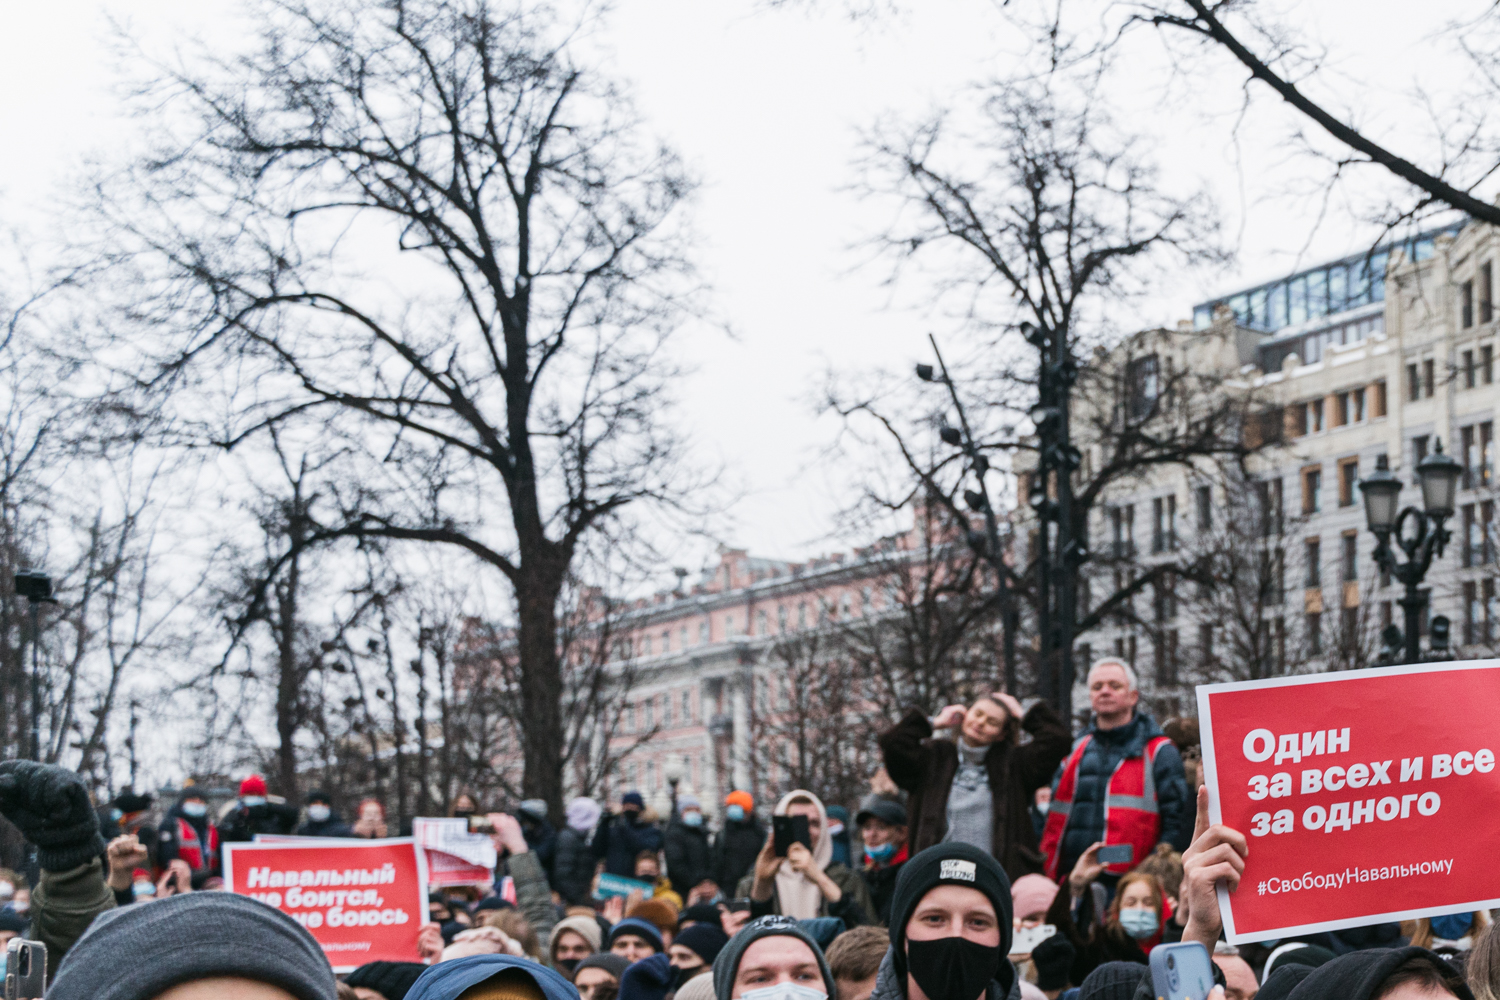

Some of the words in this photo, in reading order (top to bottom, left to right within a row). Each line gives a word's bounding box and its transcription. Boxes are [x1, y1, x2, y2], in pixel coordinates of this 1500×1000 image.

[1242, 728, 1351, 766] Один
[1247, 772, 1293, 801] за
[1300, 760, 1393, 795] всех
[1399, 757, 1424, 783] и
[1431, 748, 1496, 779] все
[1250, 809, 1295, 837] за
[1302, 791, 1441, 834] одного
[247, 862, 396, 889] Навальный
[1257, 858, 1454, 896] #СвободуНавальному
[285, 887, 384, 909] боится,
[326, 906, 409, 928] боюсь
